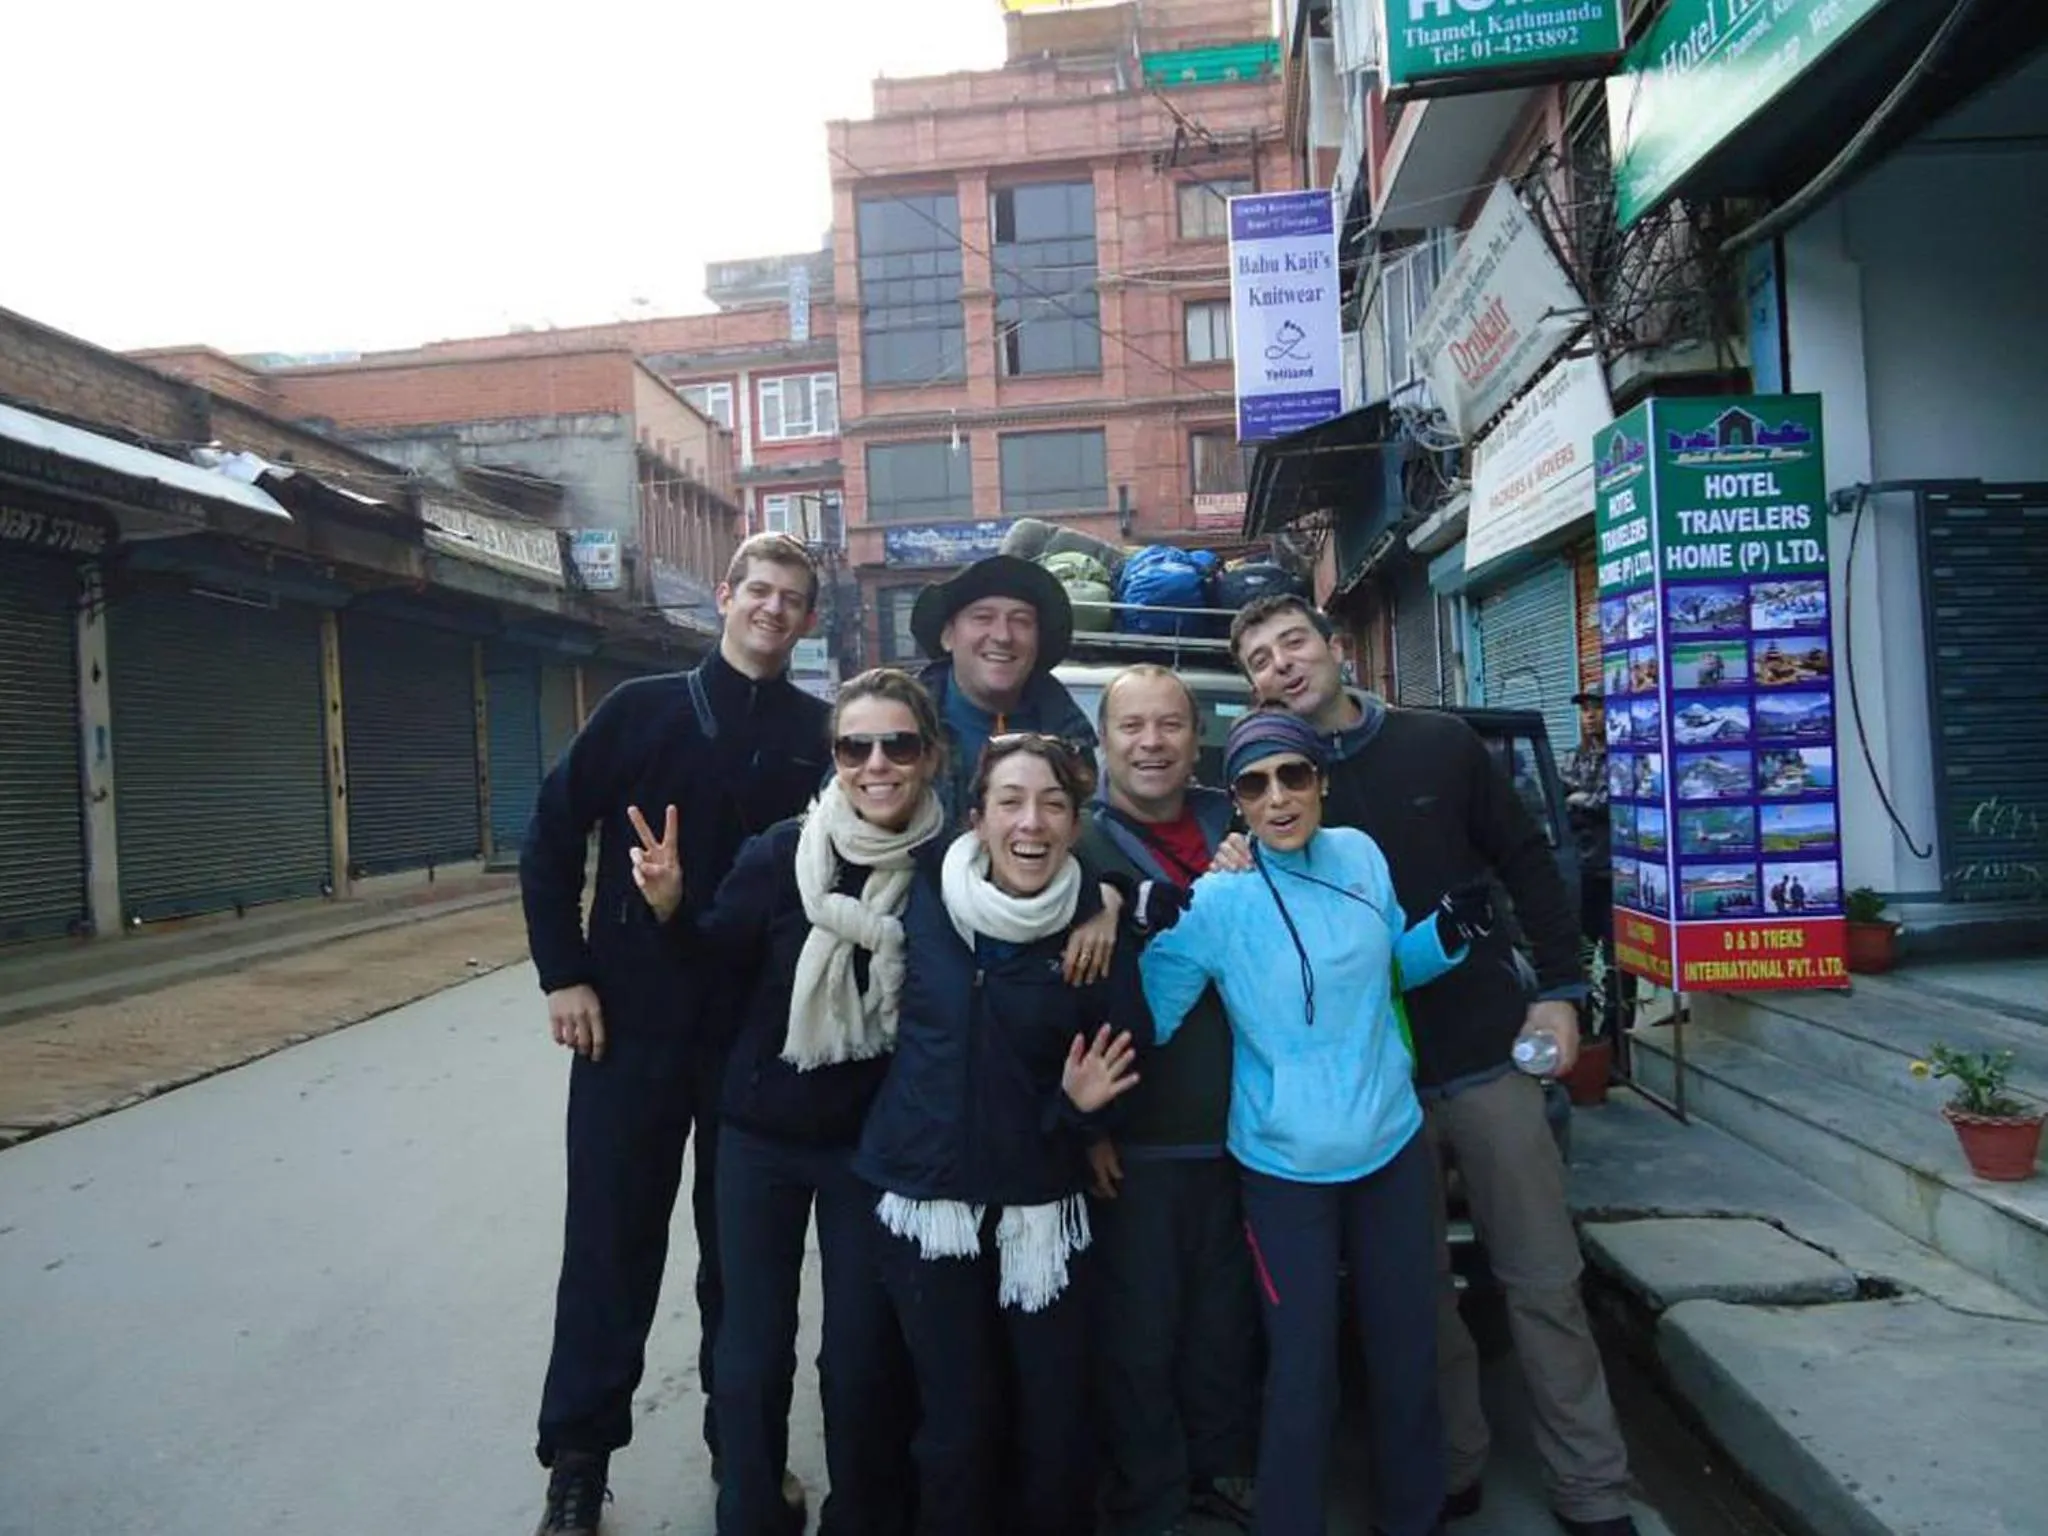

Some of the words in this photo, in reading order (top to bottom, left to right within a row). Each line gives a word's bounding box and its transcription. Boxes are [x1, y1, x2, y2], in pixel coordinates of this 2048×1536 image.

[1404, 17, 1482, 48] Thamel,
[1488, 3, 1603, 35] Kathmandu
[1430, 45, 1467, 65] Tel:
[1471, 26, 1580, 60] 01-4233892
[1239, 253, 1280, 275] Babu
[1284, 250, 1332, 275] Kaji's
[1248, 285, 1326, 307] Knitwear
[1448, 295, 1511, 380] Drukair
[1705, 471, 1782, 500] HOTEL
[1677, 504, 1811, 535] TRAVELERS
[1666, 543, 1733, 571] HOME
[1739, 540, 1770, 573] (P)
[1776, 538, 1826, 566] LTD.
[1684, 958, 1785, 982] INTERNATIONAL
[1787, 957, 1817, 979] PVT.
